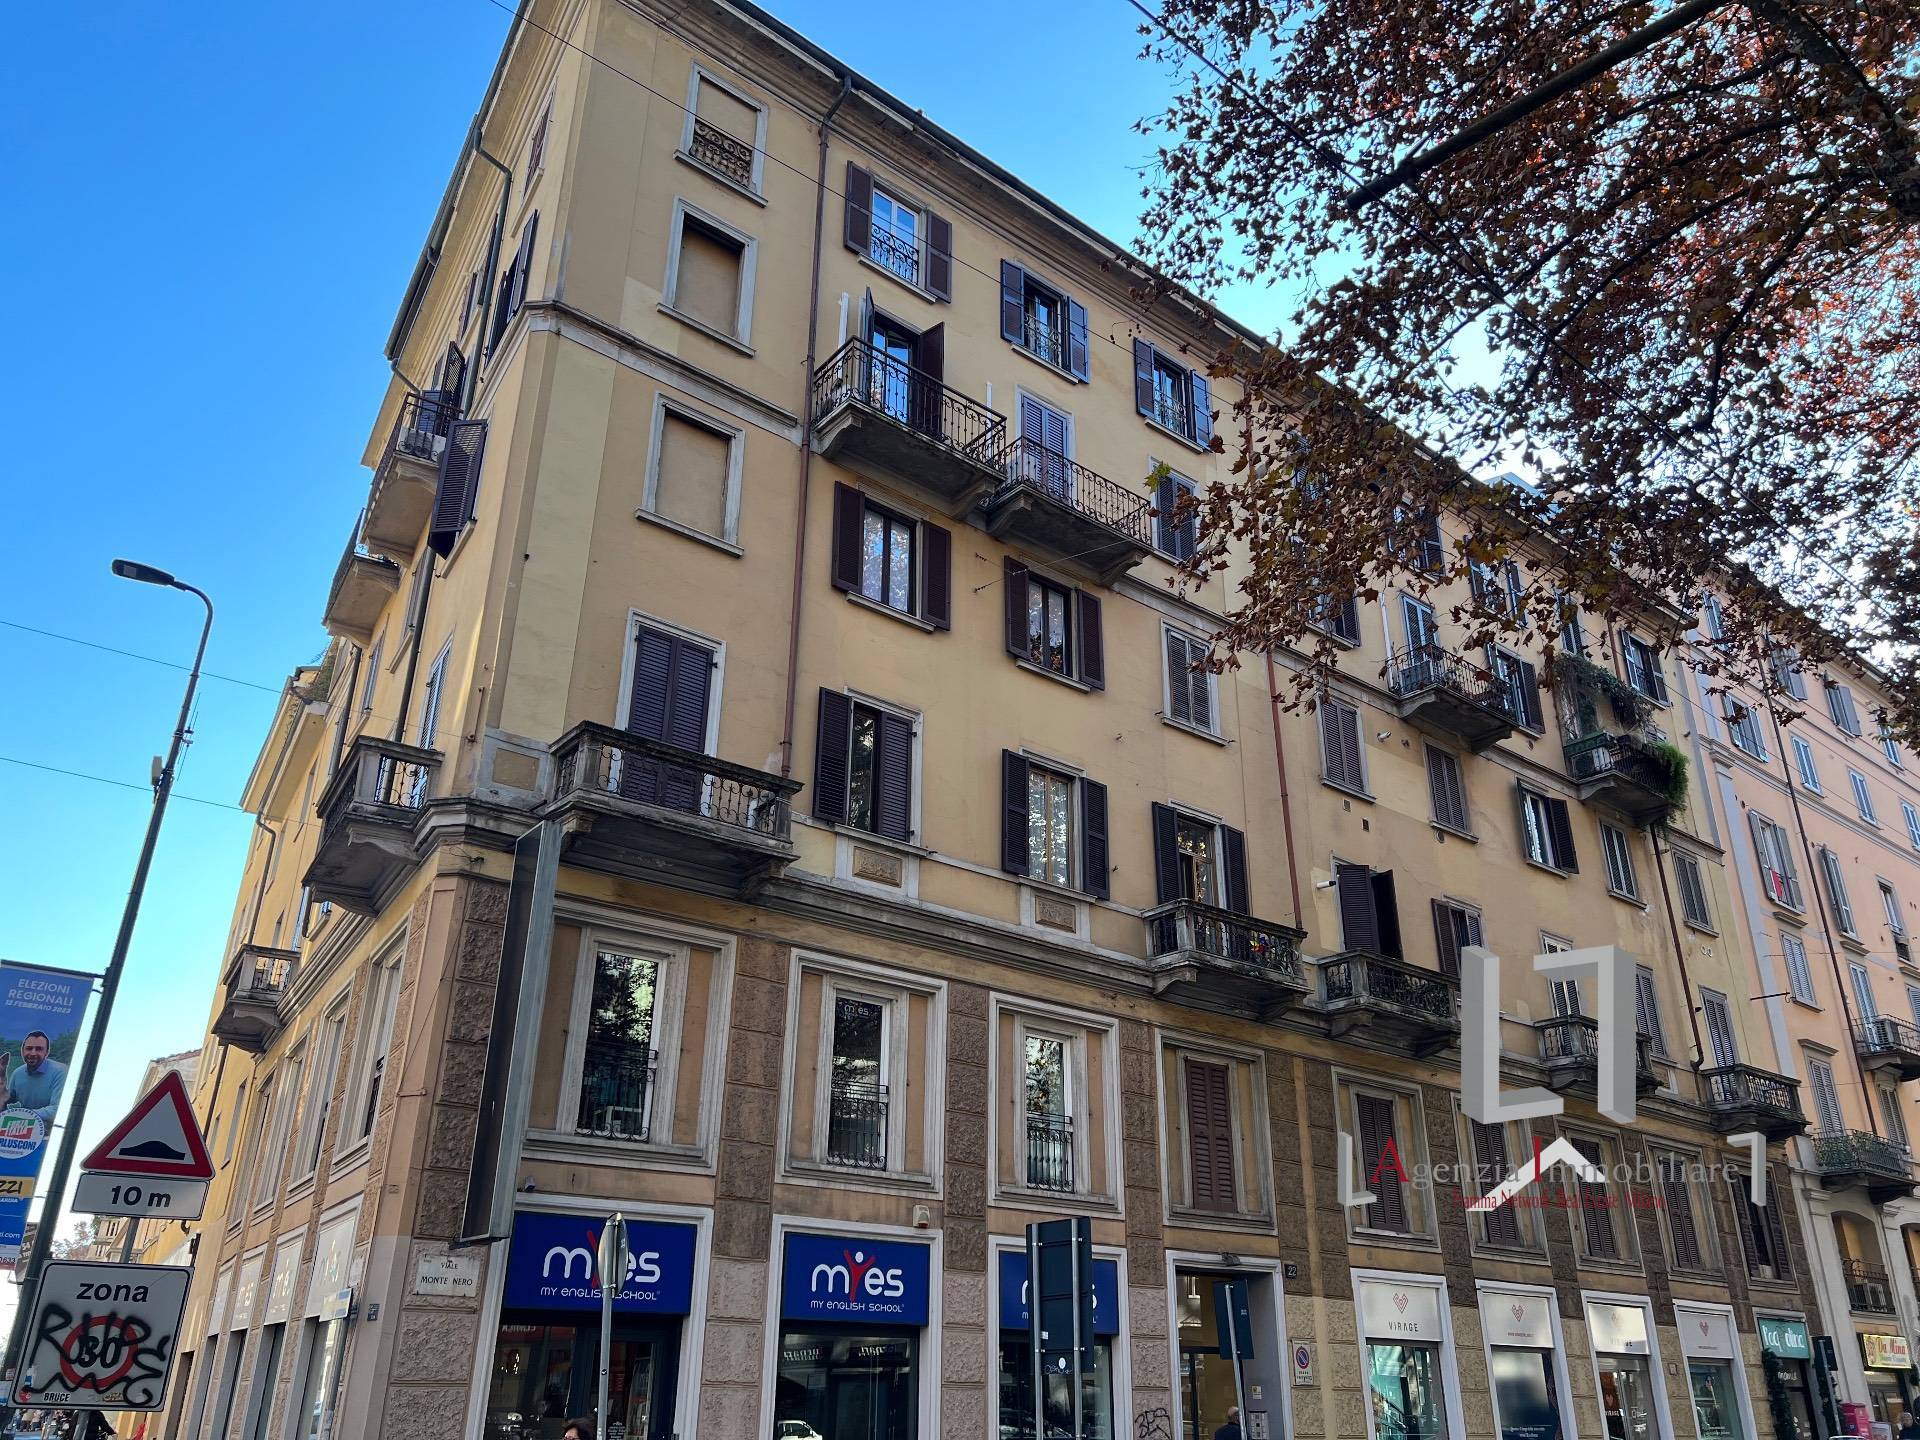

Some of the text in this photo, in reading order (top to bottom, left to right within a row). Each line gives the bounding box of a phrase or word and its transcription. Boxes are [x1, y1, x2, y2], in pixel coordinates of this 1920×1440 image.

[17, 979, 71, 994] ELEZIONI
[8, 989, 74, 1006] REGIONALI
[111, 1185, 171, 1208] 10 m
[441, 1262, 458, 1270] VIALE
[1288, 1265, 1297, 1276] 22
[420, 1276, 473, 1286] MONTE NERO
[76, 1282, 149, 1303] zona
[868, 1303, 903, 1313] SCHOOL
[1388, 1321, 1419, 1333] VIRAGE
[43, 1392, 71, 1402] BRUCE
